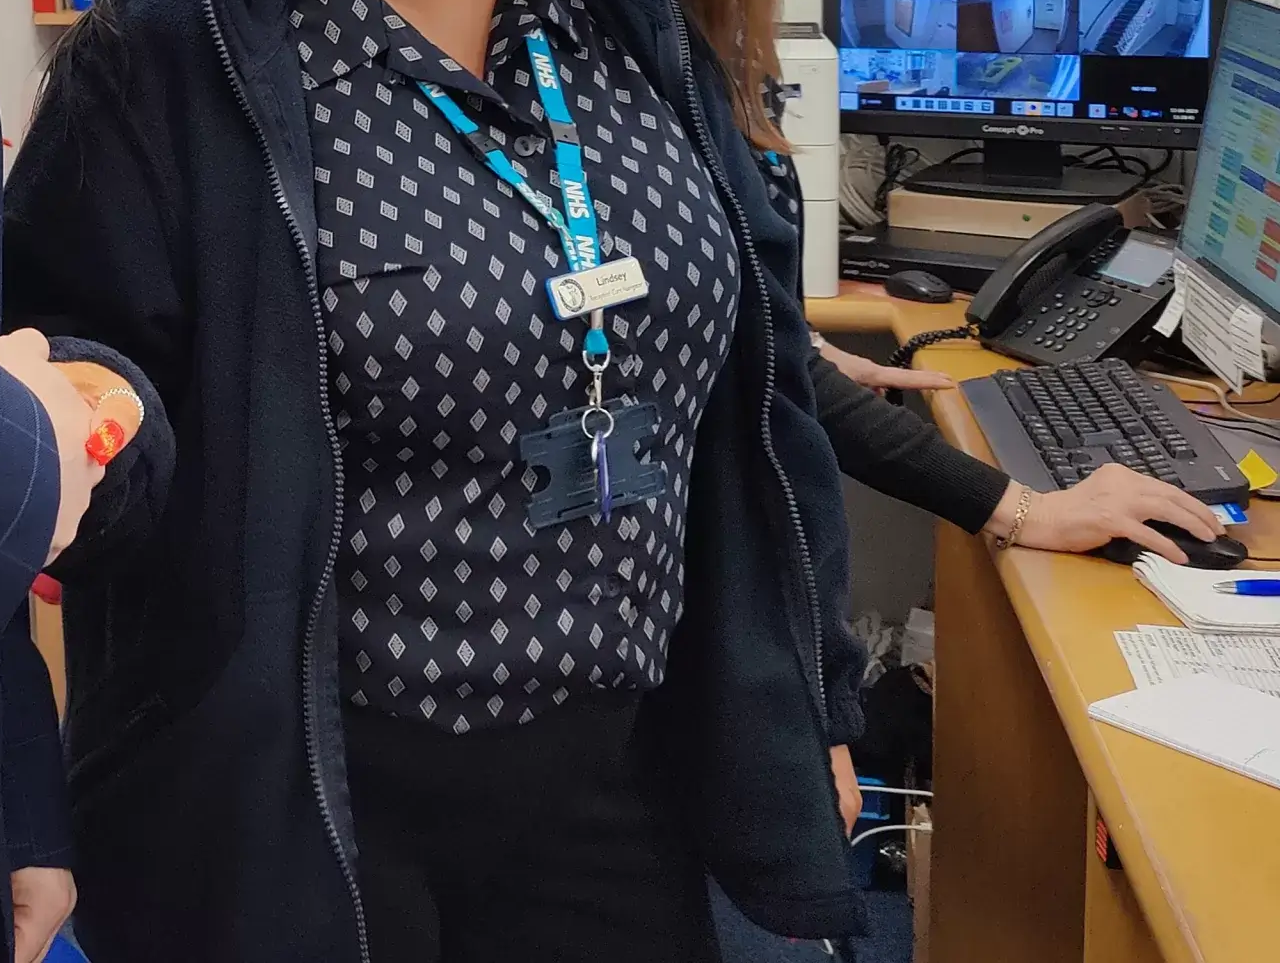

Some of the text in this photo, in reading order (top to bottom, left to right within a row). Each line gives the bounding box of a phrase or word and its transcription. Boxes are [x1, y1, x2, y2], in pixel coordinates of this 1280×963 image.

[532, 51, 558, 90] NHS
[981, 124, 1045, 135] Concept Pro
[564, 179, 590, 219] NHS
[575, 235, 597, 271] NH
[596, 272, 627, 287] Lindsey
